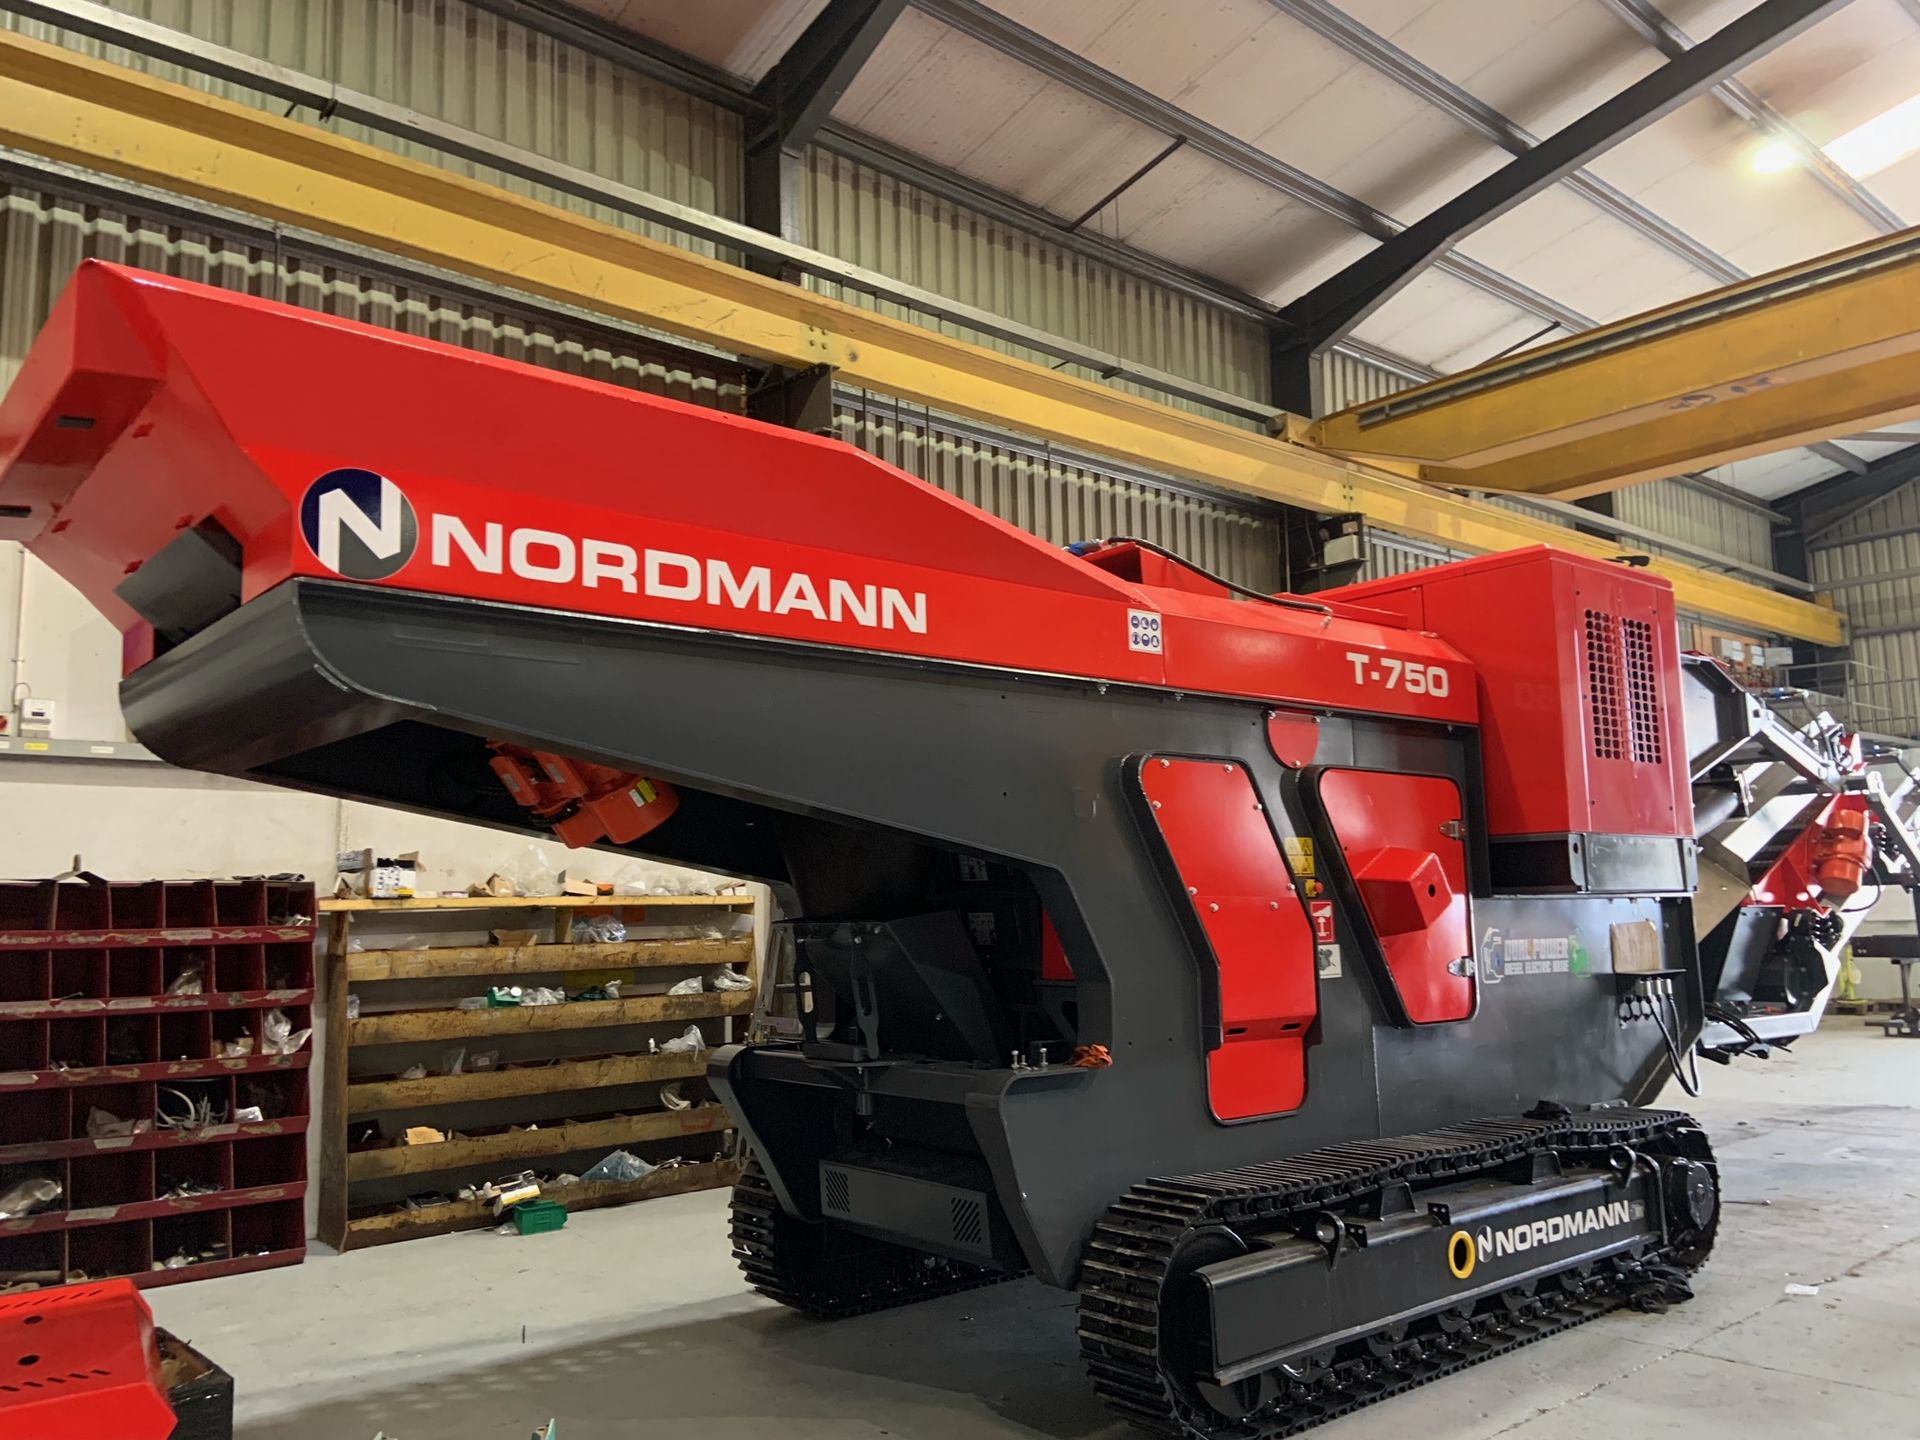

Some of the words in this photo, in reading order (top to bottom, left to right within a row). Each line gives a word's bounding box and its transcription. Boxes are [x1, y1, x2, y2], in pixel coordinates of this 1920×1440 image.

[432, 513, 927, 634] NORDMANN
[1346, 652, 1449, 697] T-750
[1495, 1200, 1630, 1257] NORDMANN
